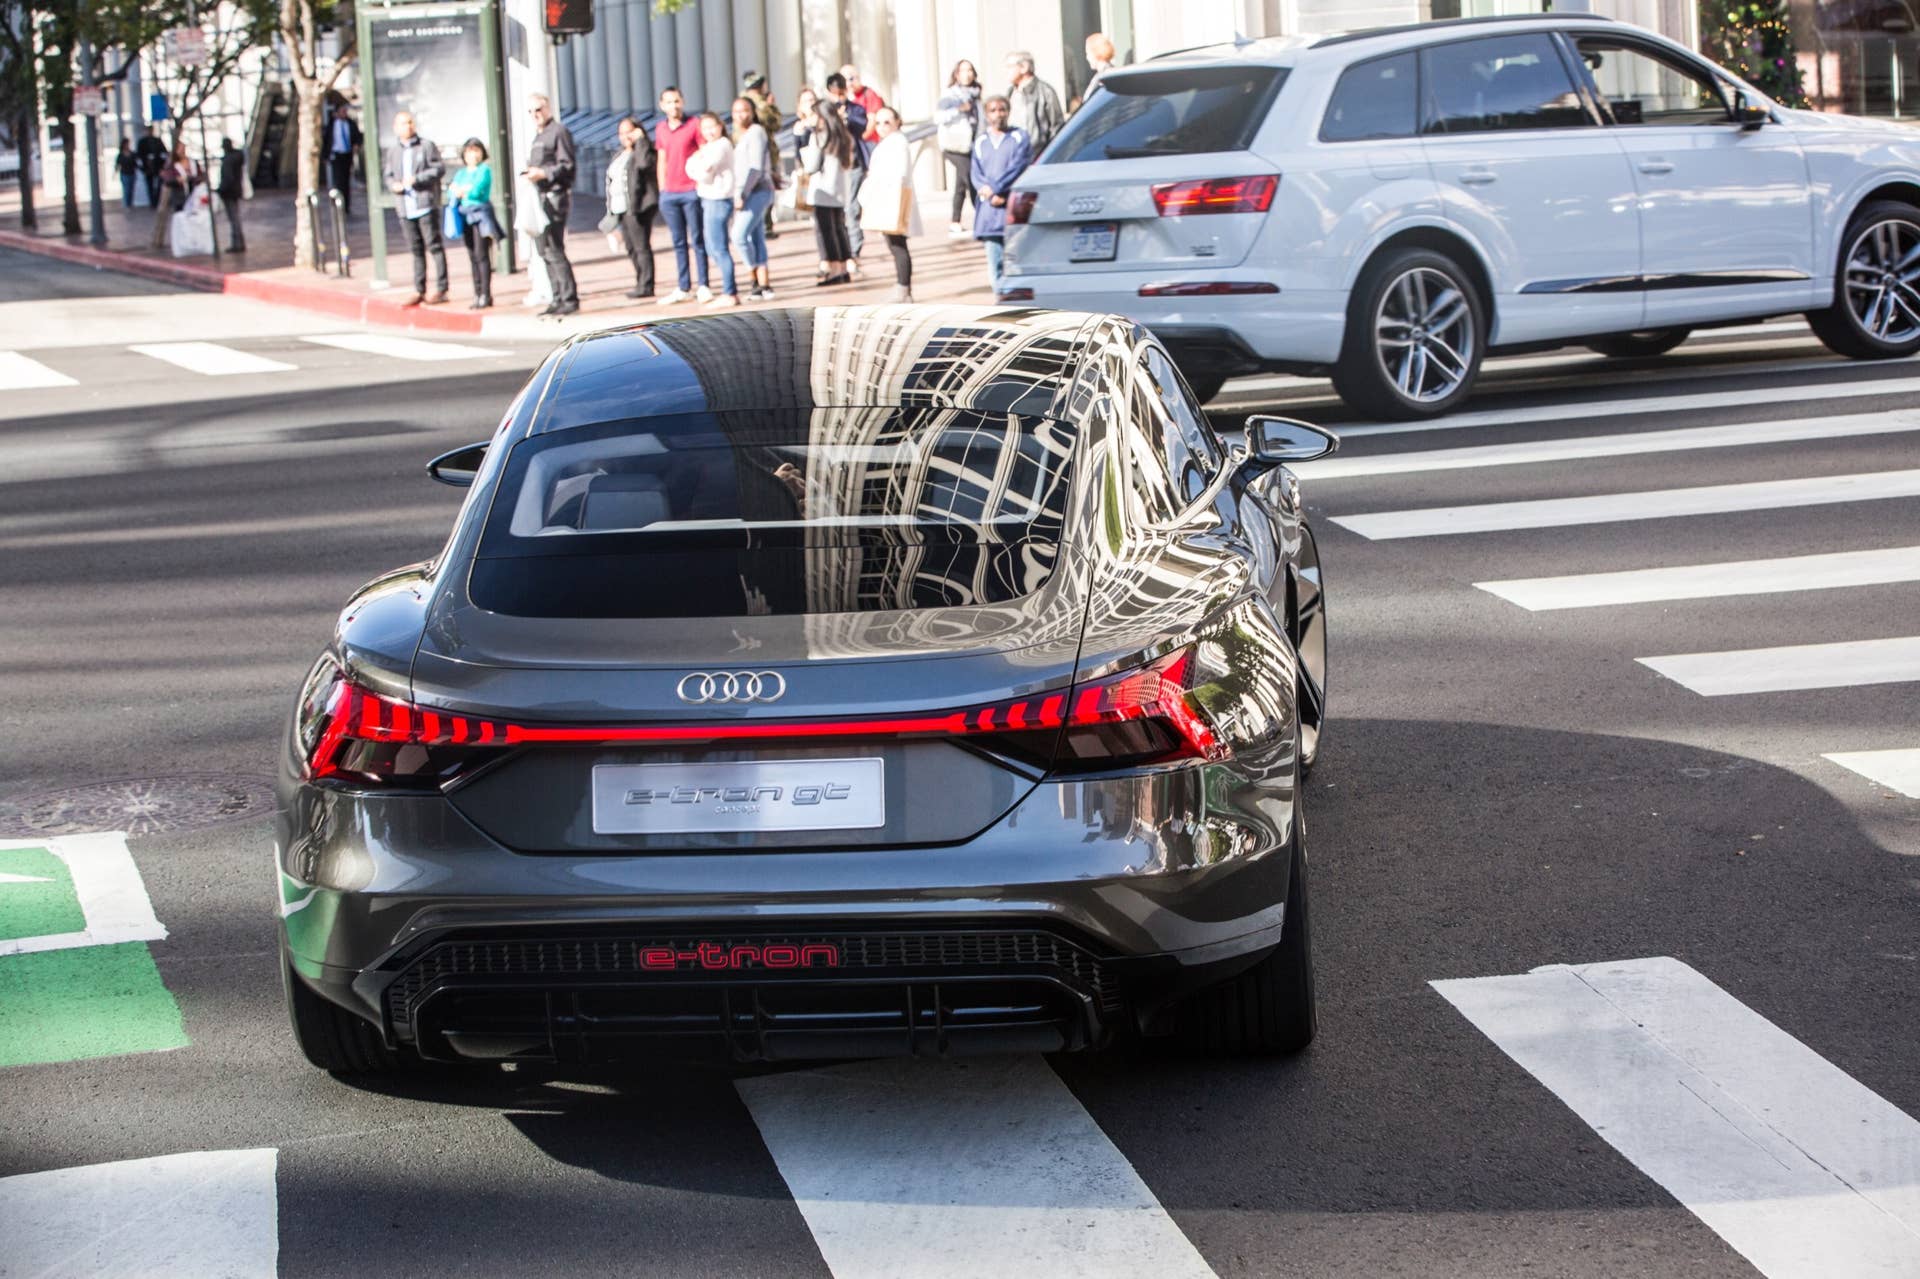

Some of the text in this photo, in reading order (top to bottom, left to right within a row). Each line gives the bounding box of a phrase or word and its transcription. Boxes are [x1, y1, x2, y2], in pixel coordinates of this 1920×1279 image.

[624, 782, 851, 806] e-tron gt
[639, 942, 839, 970] e-tron
